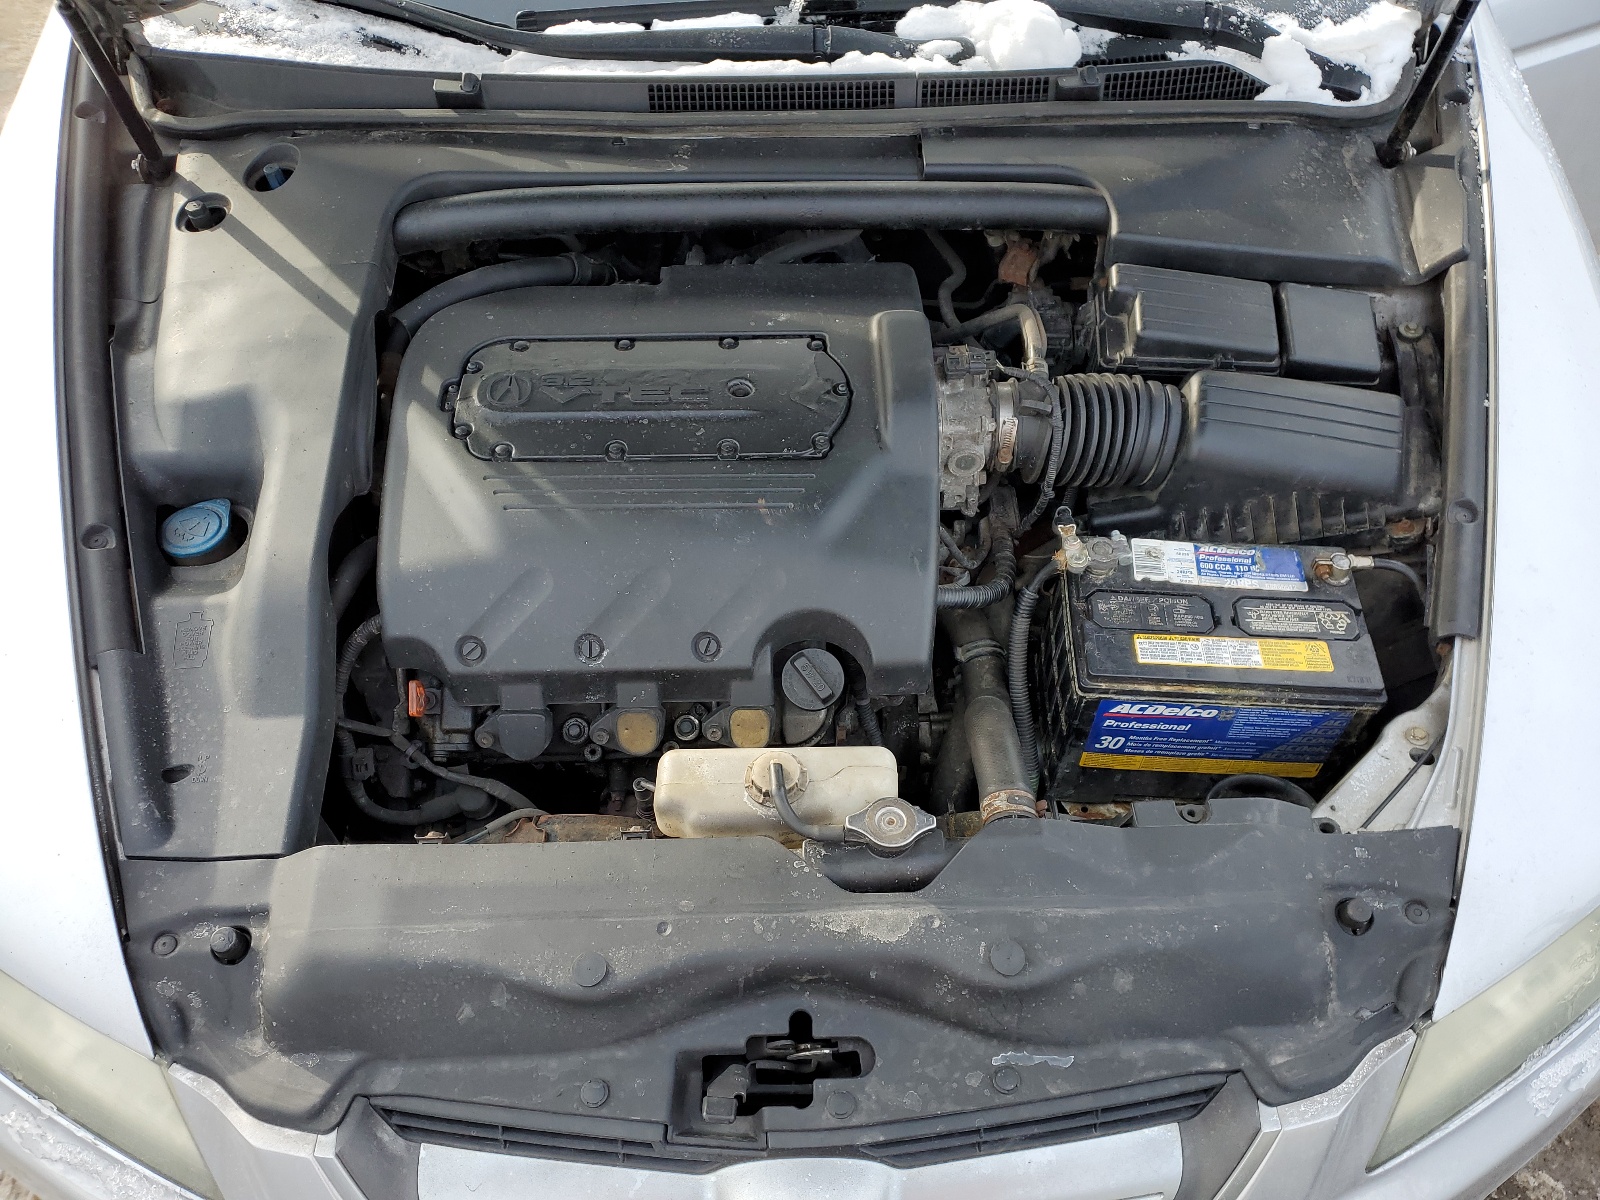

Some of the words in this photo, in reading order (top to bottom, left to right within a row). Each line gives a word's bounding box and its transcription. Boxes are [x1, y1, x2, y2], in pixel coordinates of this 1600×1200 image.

[1198, 545, 1256, 556] ACDelco
[1199, 553, 1252, 564] Professional
[1200, 562, 1214, 570] 600
[1215, 563, 1232, 571] CCA
[1108, 703, 1219, 718] ACDelco
[1103, 719, 1192, 731] Professional
[1094, 735, 1126, 750] 30
